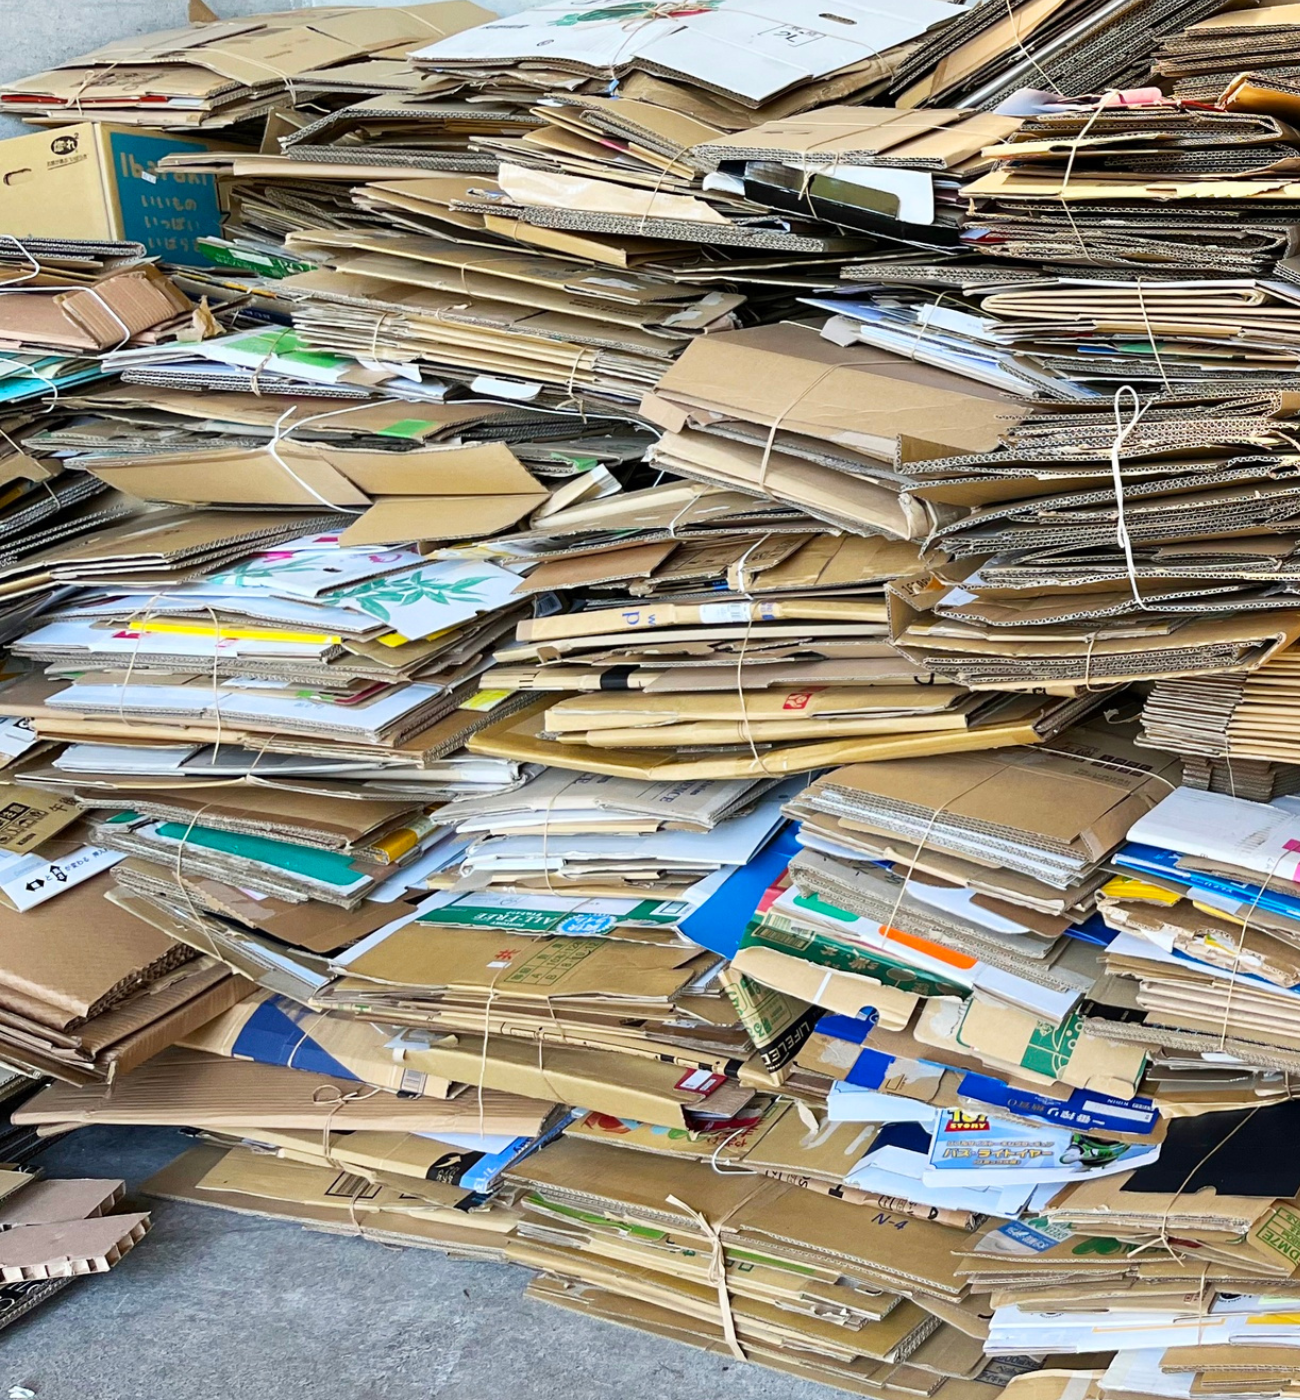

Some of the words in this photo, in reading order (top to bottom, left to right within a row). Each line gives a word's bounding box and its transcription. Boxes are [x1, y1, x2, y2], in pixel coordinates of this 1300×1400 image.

[141, 194, 196, 211] いいもの
[1047, 1107, 1106, 1126] 一番搾り
[871, 1213, 908, 1230] N-4
